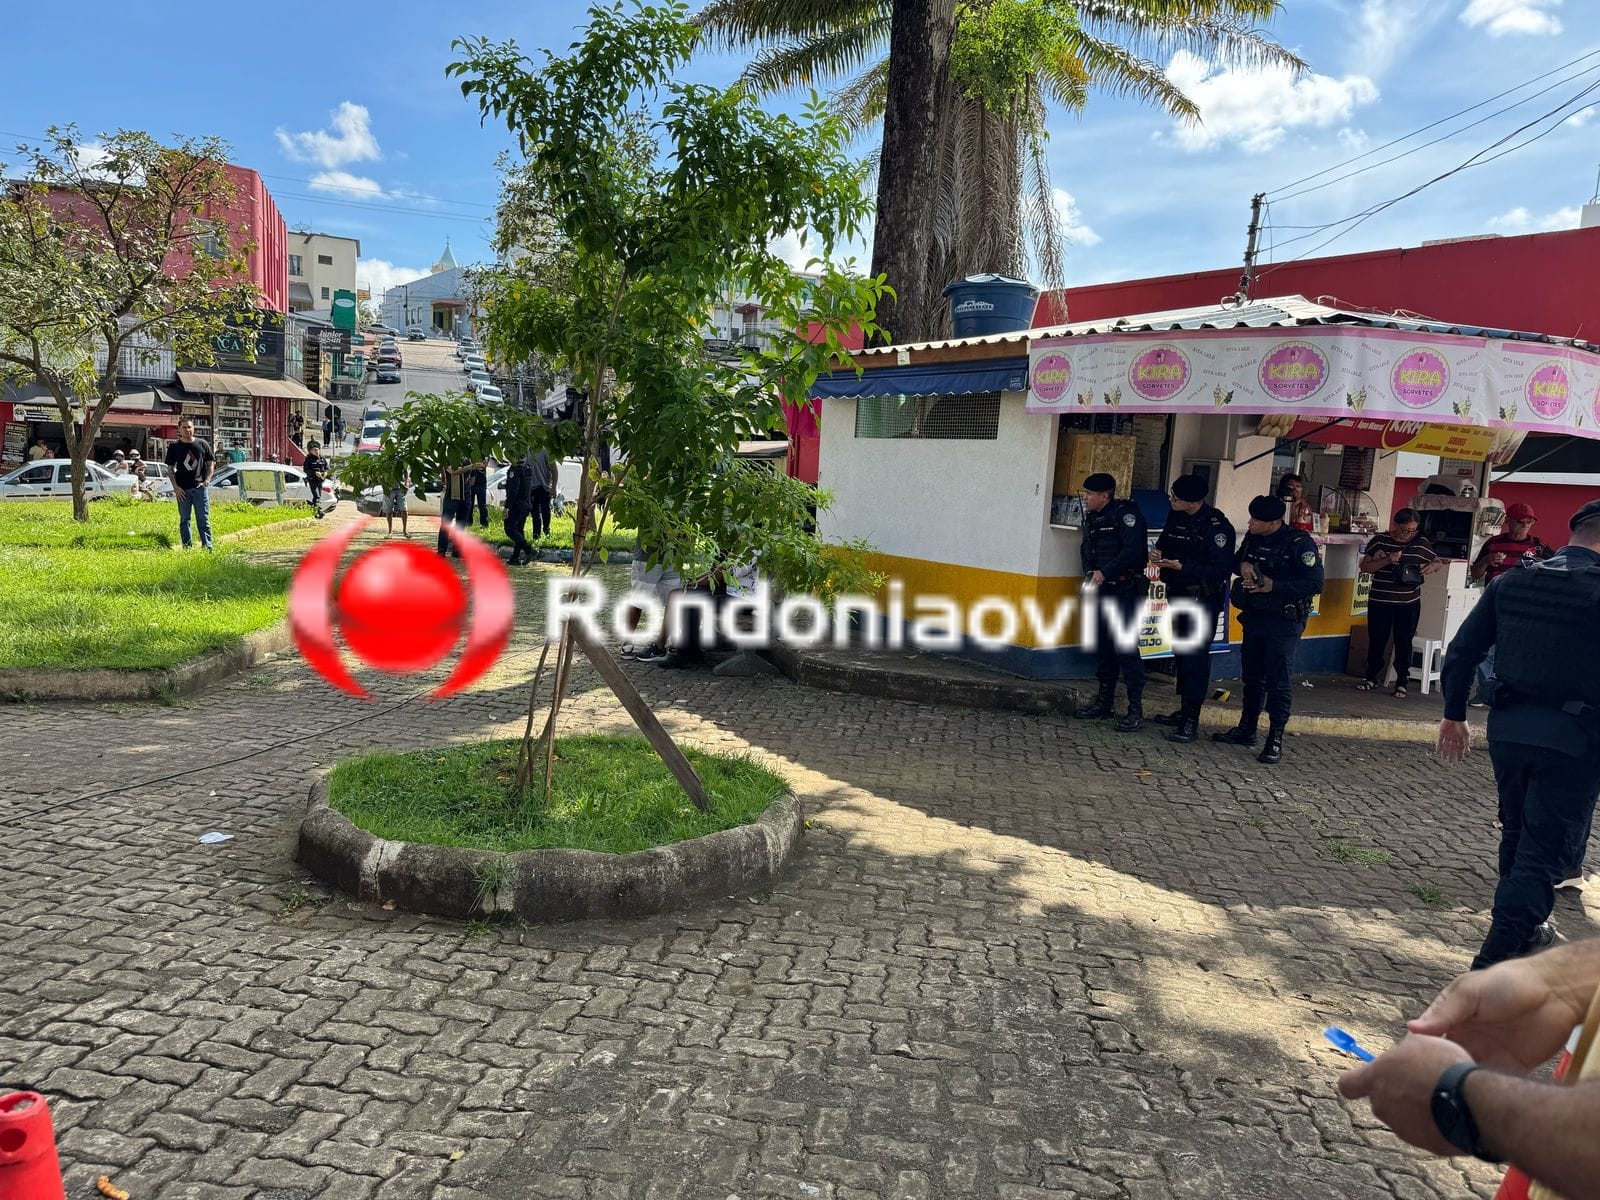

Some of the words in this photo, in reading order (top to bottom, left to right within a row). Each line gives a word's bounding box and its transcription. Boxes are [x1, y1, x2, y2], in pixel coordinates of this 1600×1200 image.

[1137, 363, 1183, 380] KIRA
[1268, 362, 1319, 380] KIRA
[1399, 368, 1442, 386] KIRA
[1402, 388, 1433, 397] SORVETES
